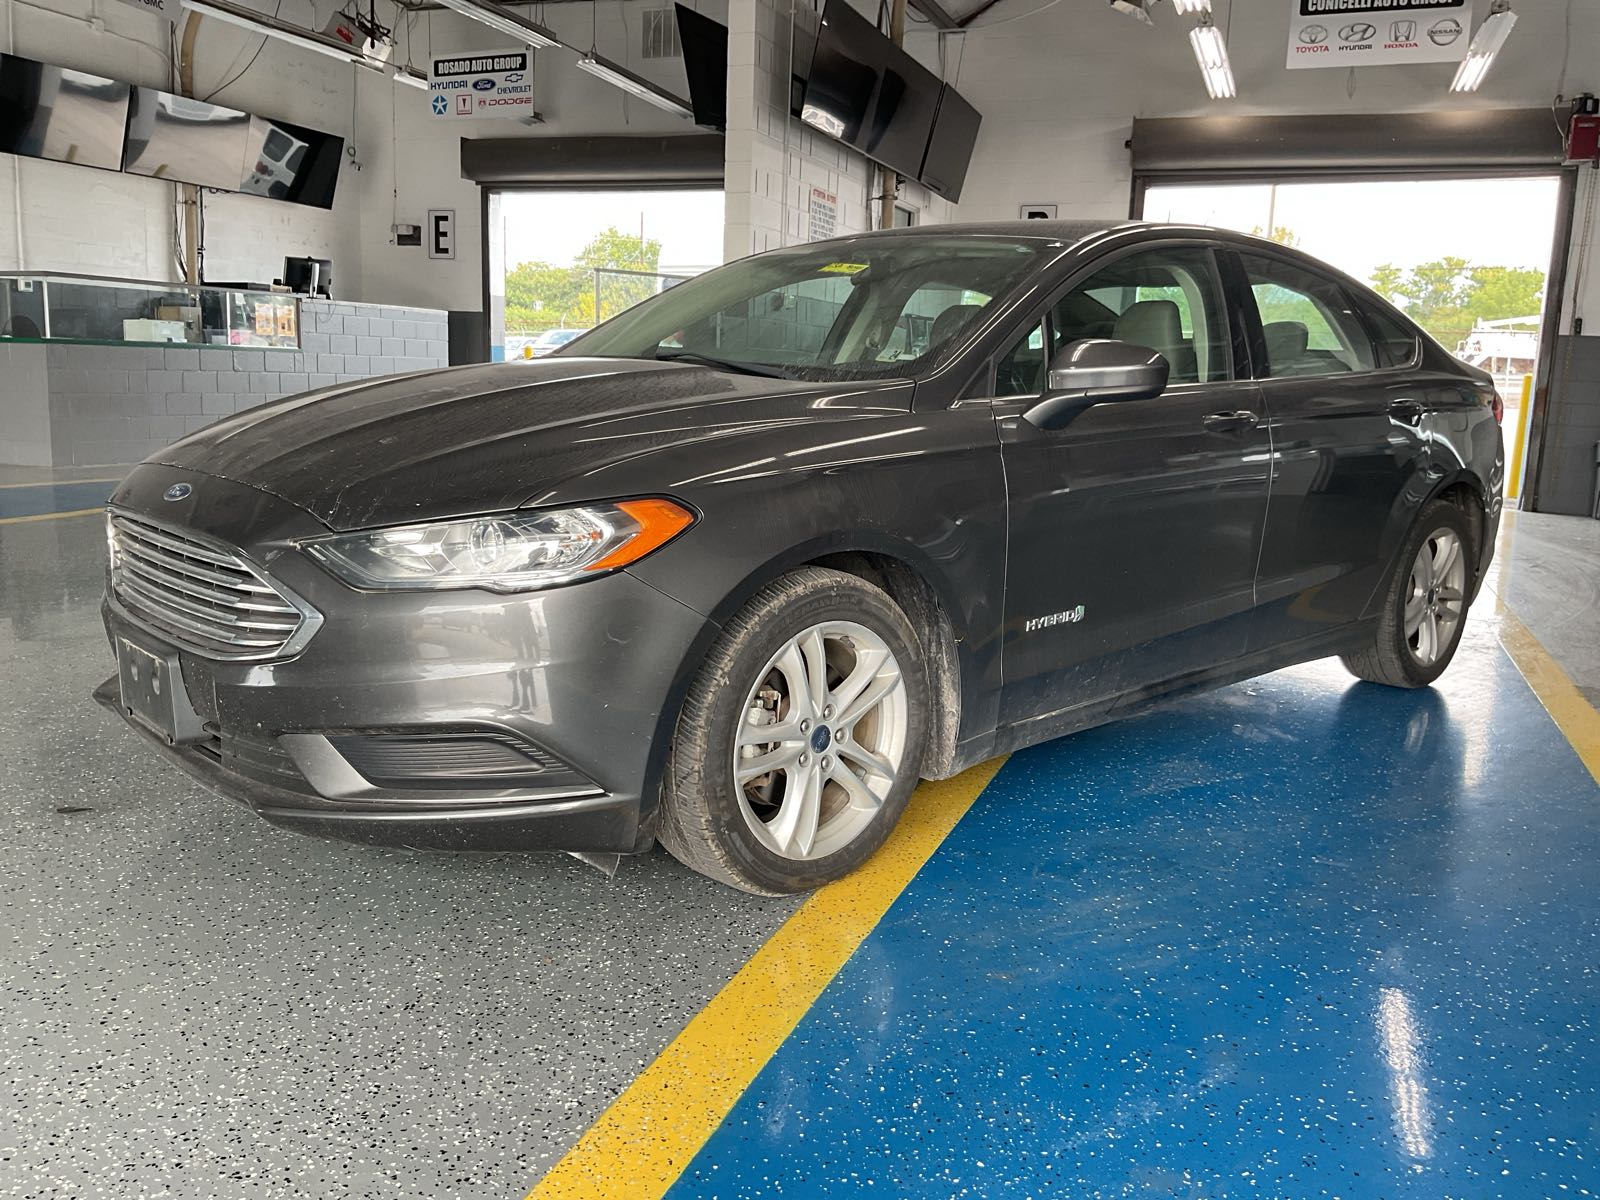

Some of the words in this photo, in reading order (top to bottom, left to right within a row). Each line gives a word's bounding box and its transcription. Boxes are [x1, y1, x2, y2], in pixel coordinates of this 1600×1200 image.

[1308, 0, 1371, 11] CONICELLI
[438, 60, 470, 74] ROSADO
[471, 59, 492, 72] AUTO
[494, 57, 522, 70] GROUP
[430, 80, 468, 90] HYUNDAI
[497, 85, 532, 95] CHEVROLET
[488, 97, 532, 106] DODGE
[434, 215, 449, 254] E
[1025, 610, 1075, 632] HYBRID
